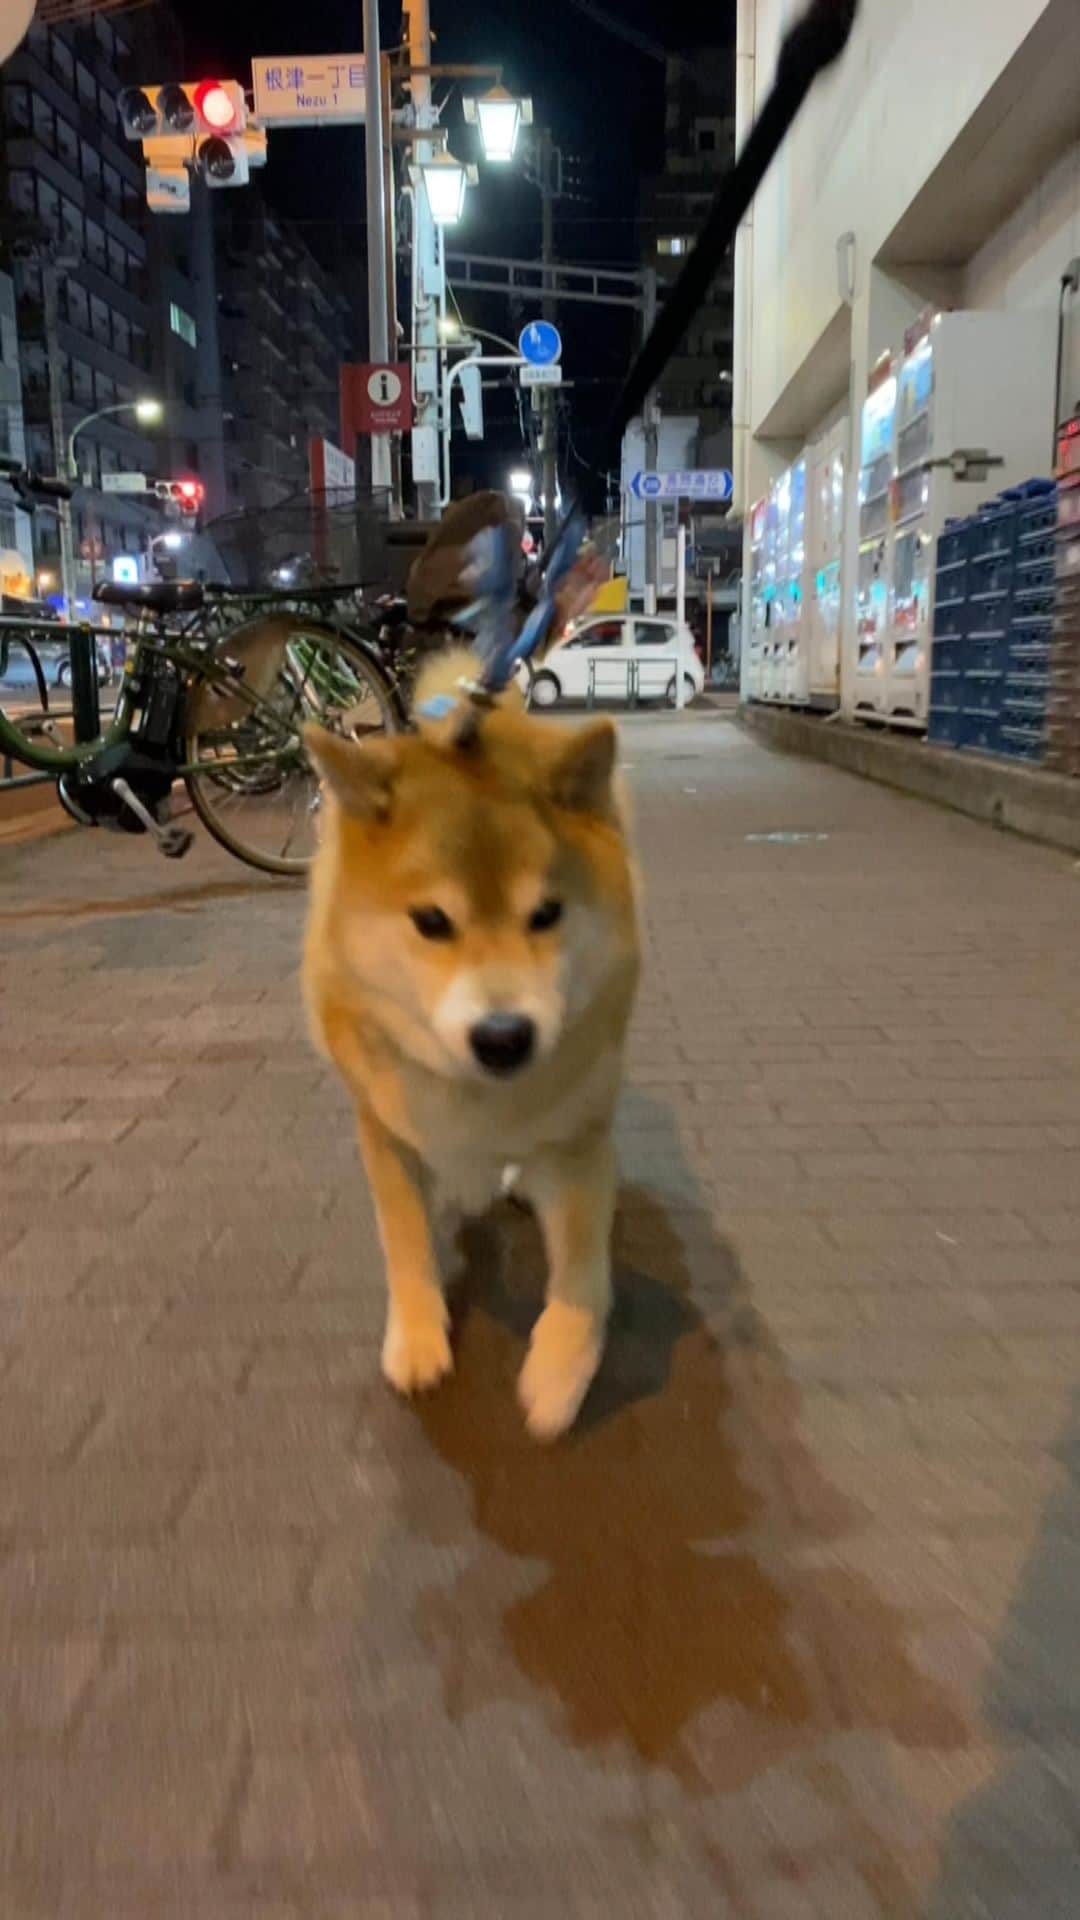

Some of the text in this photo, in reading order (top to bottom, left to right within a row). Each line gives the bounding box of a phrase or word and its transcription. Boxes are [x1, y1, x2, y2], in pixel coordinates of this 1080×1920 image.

[265, 65, 368, 91] 根津一丁目
[296, 93, 327, 108] Nezu
